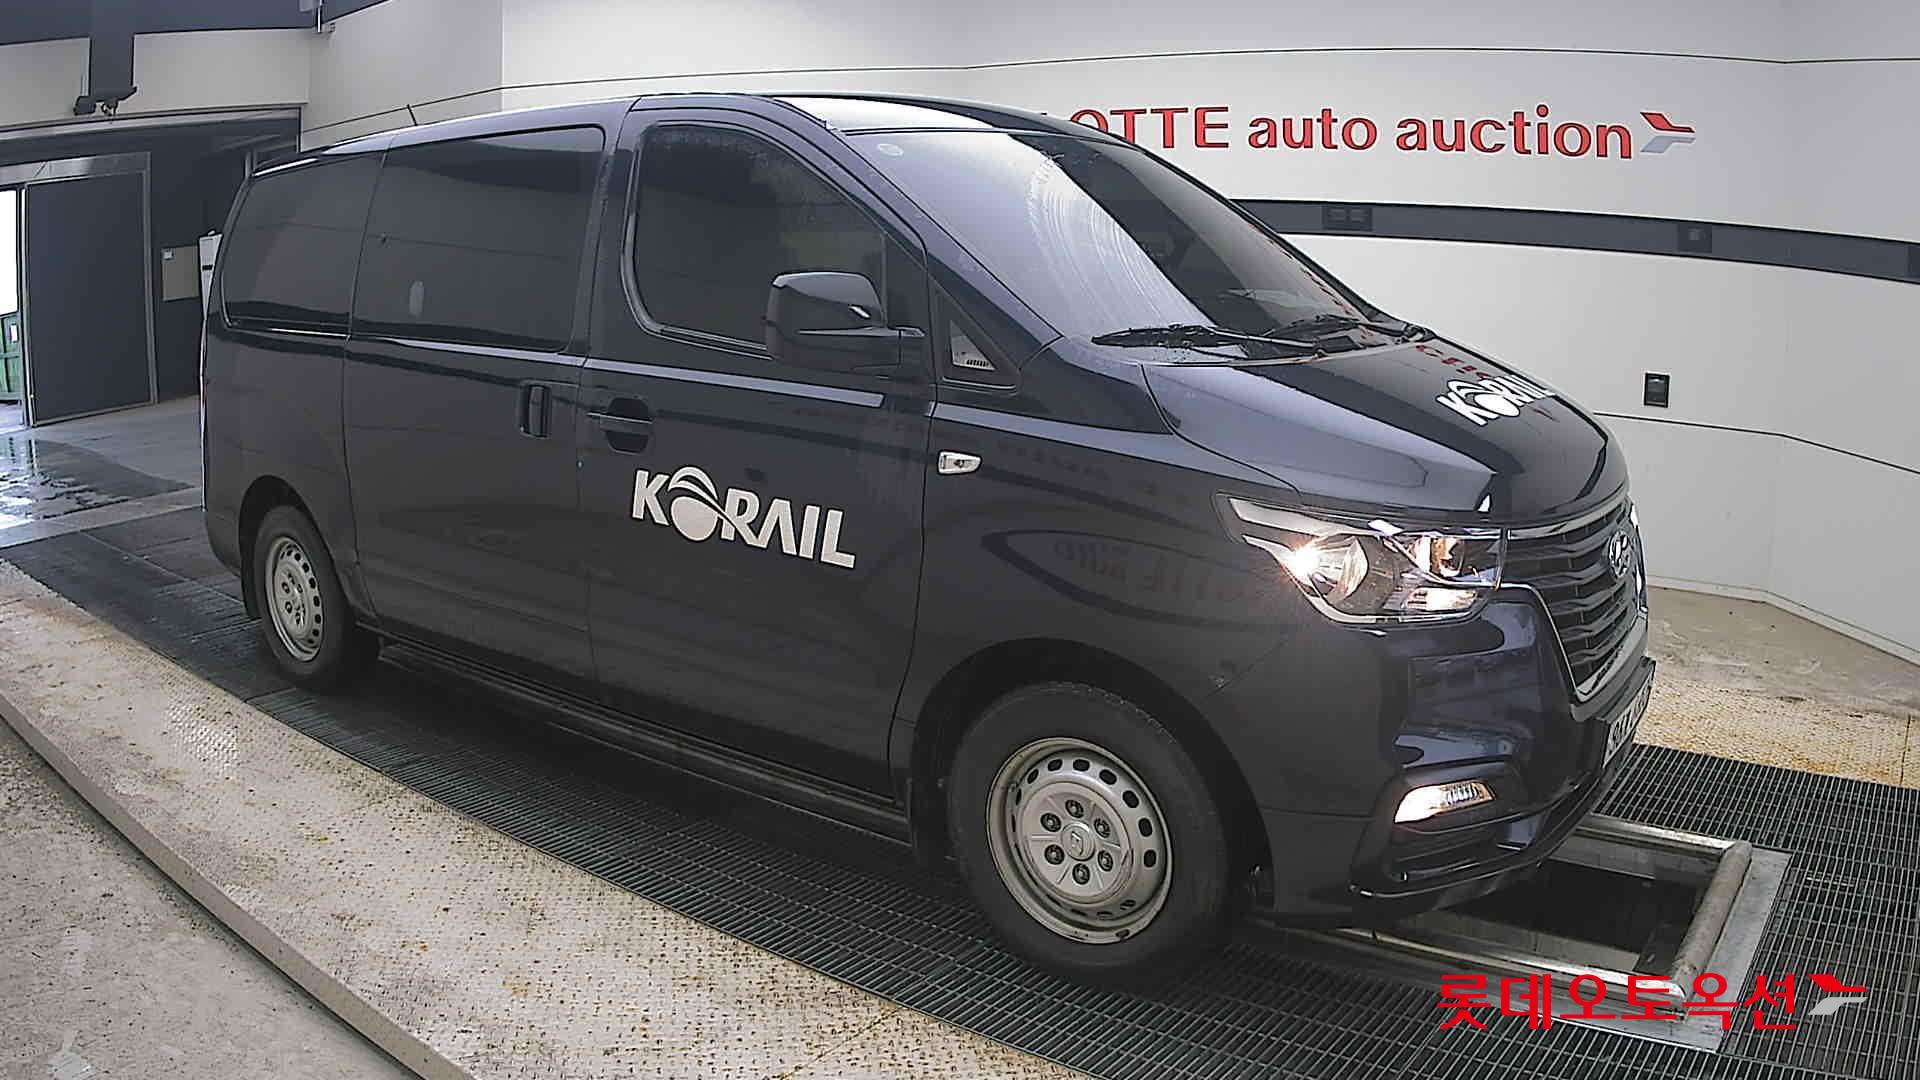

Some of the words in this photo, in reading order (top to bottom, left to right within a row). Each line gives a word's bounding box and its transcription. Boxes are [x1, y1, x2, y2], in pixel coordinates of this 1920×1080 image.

[1248, 108, 1377, 150] auto
[1396, 104, 1633, 160] auction
[631, 466, 856, 569] KORAIL
